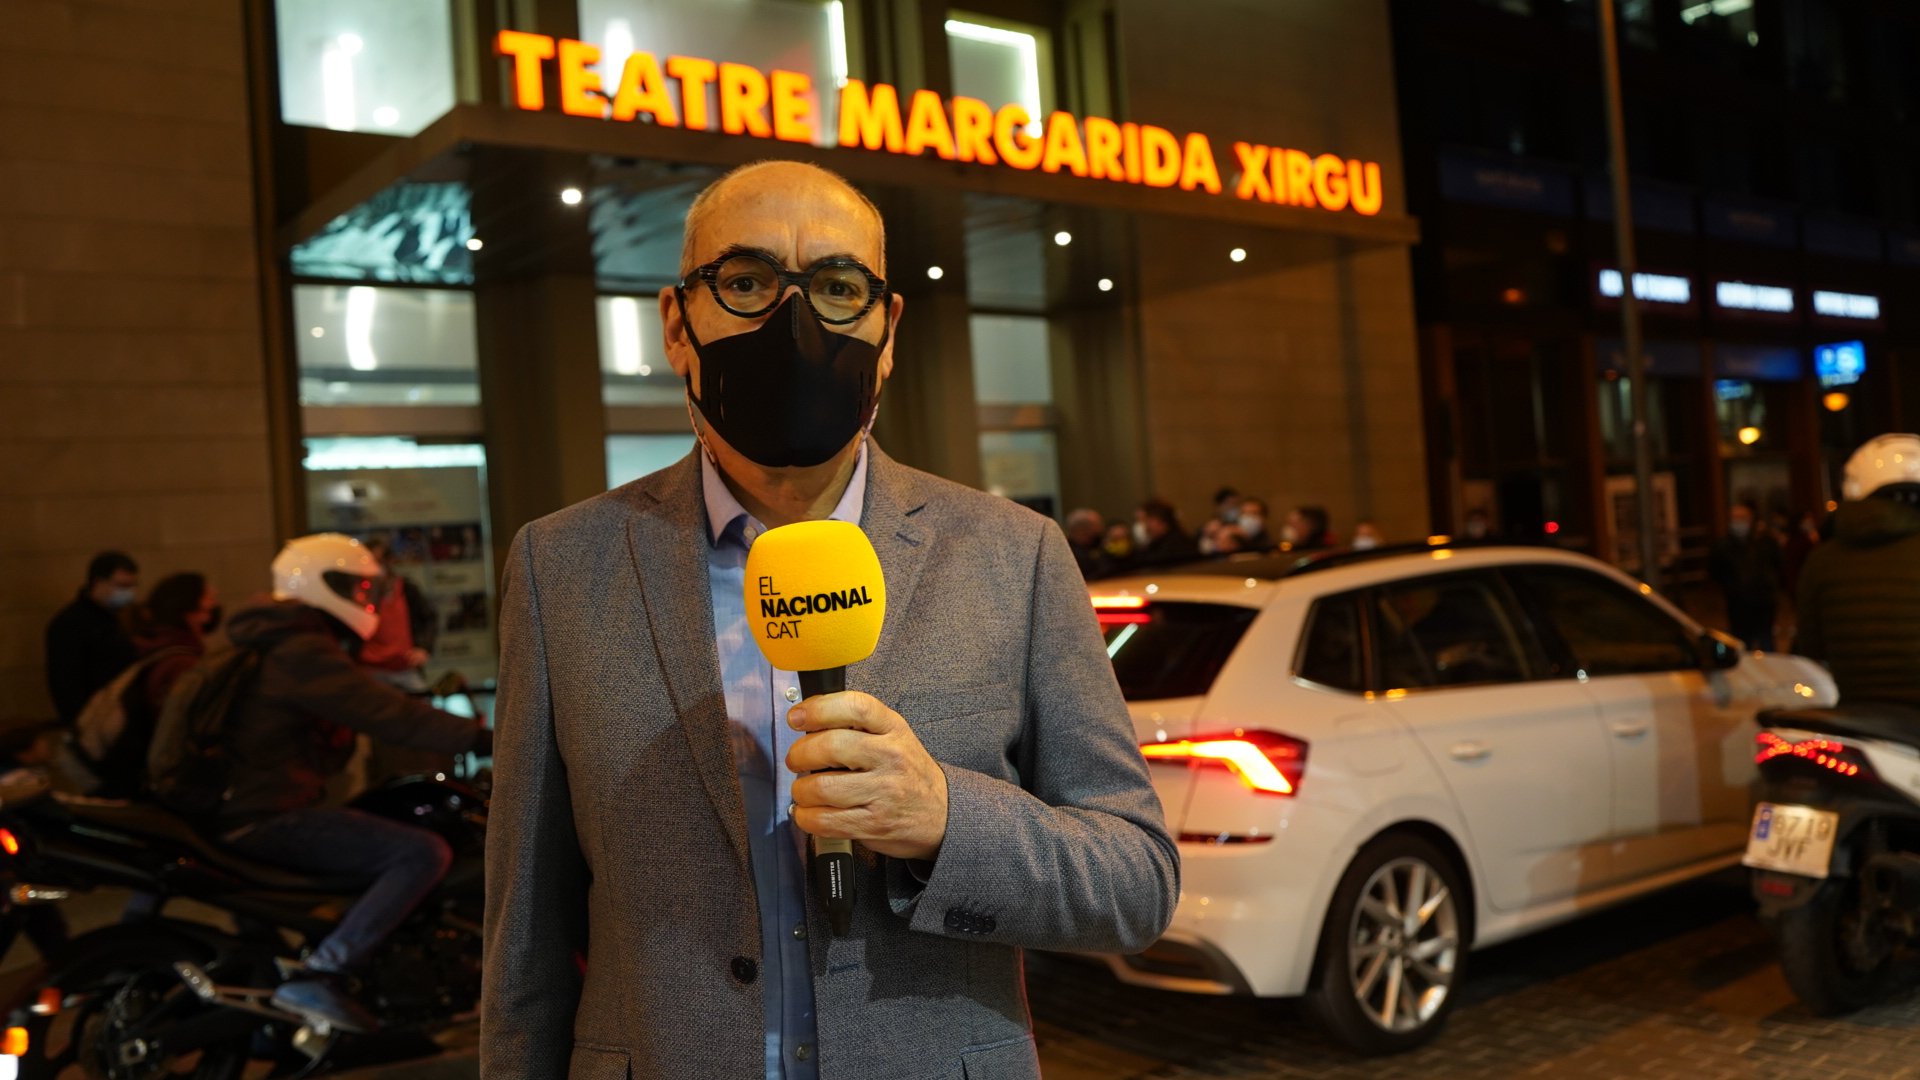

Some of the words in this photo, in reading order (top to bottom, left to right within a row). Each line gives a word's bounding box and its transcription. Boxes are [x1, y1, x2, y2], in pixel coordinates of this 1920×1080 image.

[497, 29, 820, 145] TEATRE
[838, 78, 1222, 195] MARGARIDA
[1232, 140, 1383, 216] XIRGU
[758, 576, 781, 596] EL
[760, 585, 873, 618] NACIONAL
[766, 620, 802, 639] .CAT
[829, 861, 837, 898] TRANSMITTER
